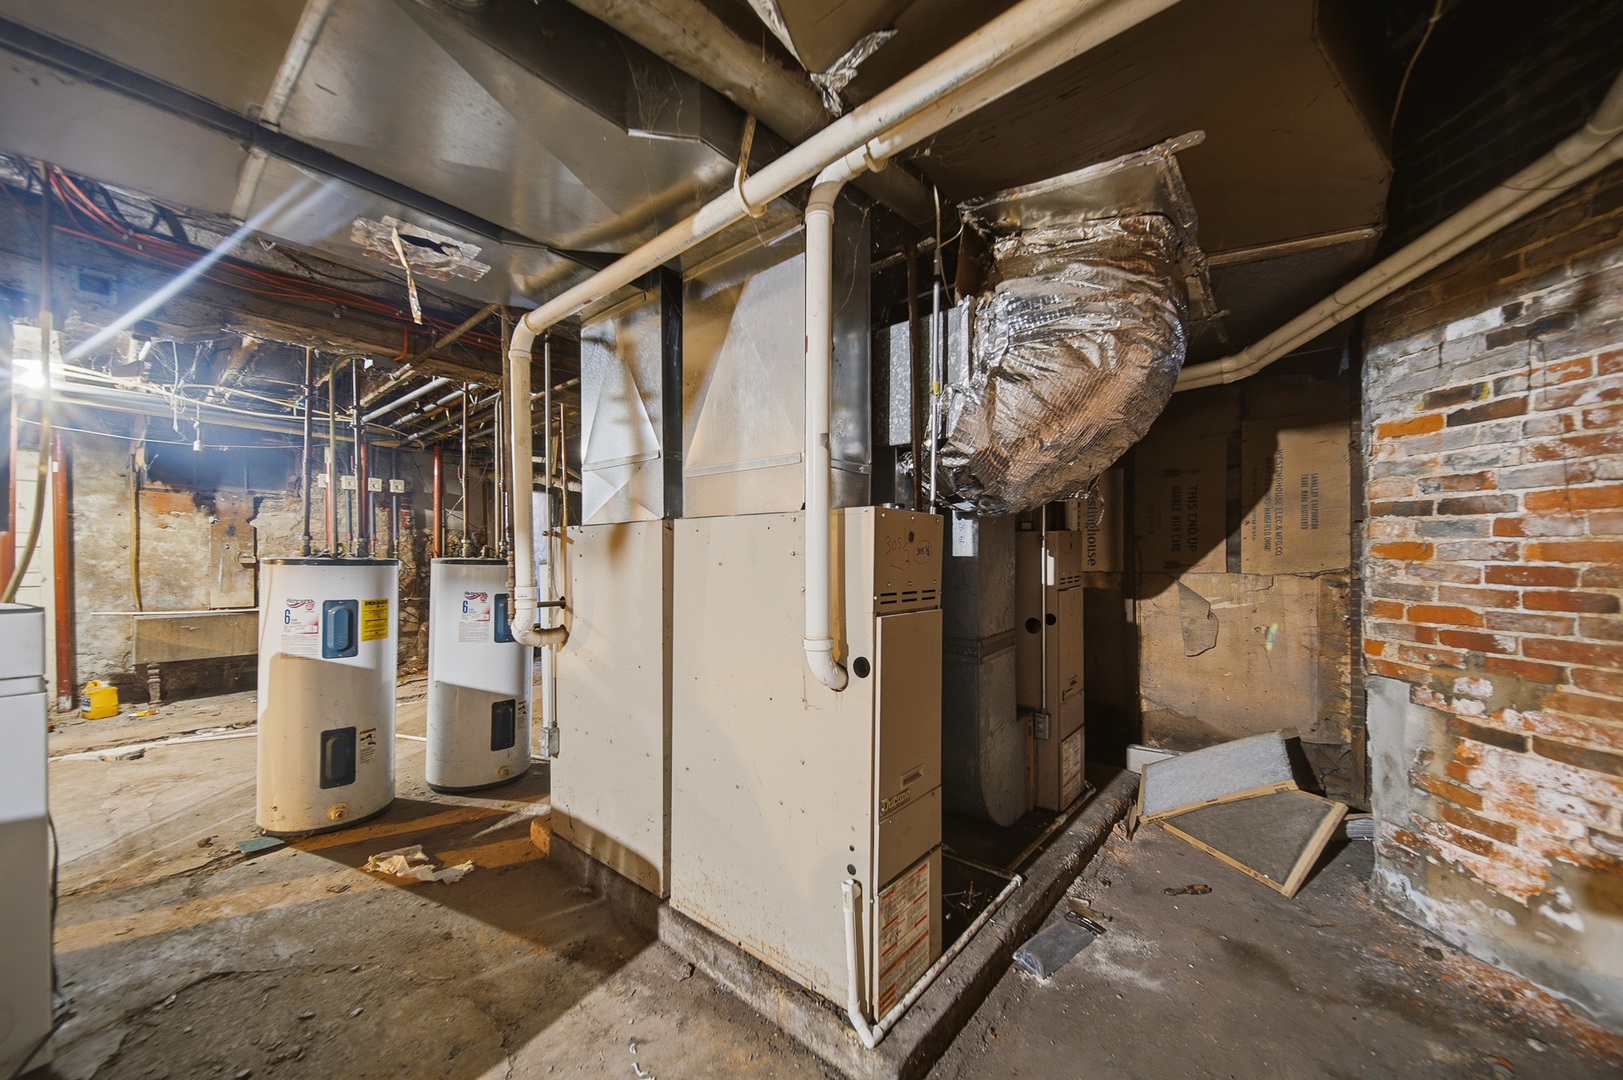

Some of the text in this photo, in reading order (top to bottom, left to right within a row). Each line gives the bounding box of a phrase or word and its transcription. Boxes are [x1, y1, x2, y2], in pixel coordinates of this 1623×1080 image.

[1275, 448, 1284, 506] WESTINGHOUSE
[1085, 500, 1100, 566] stinghouse
[1187, 485, 1198, 552] THIS END UP
[284, 609, 291, 625] 6
[462, 600, 469, 614] 6
